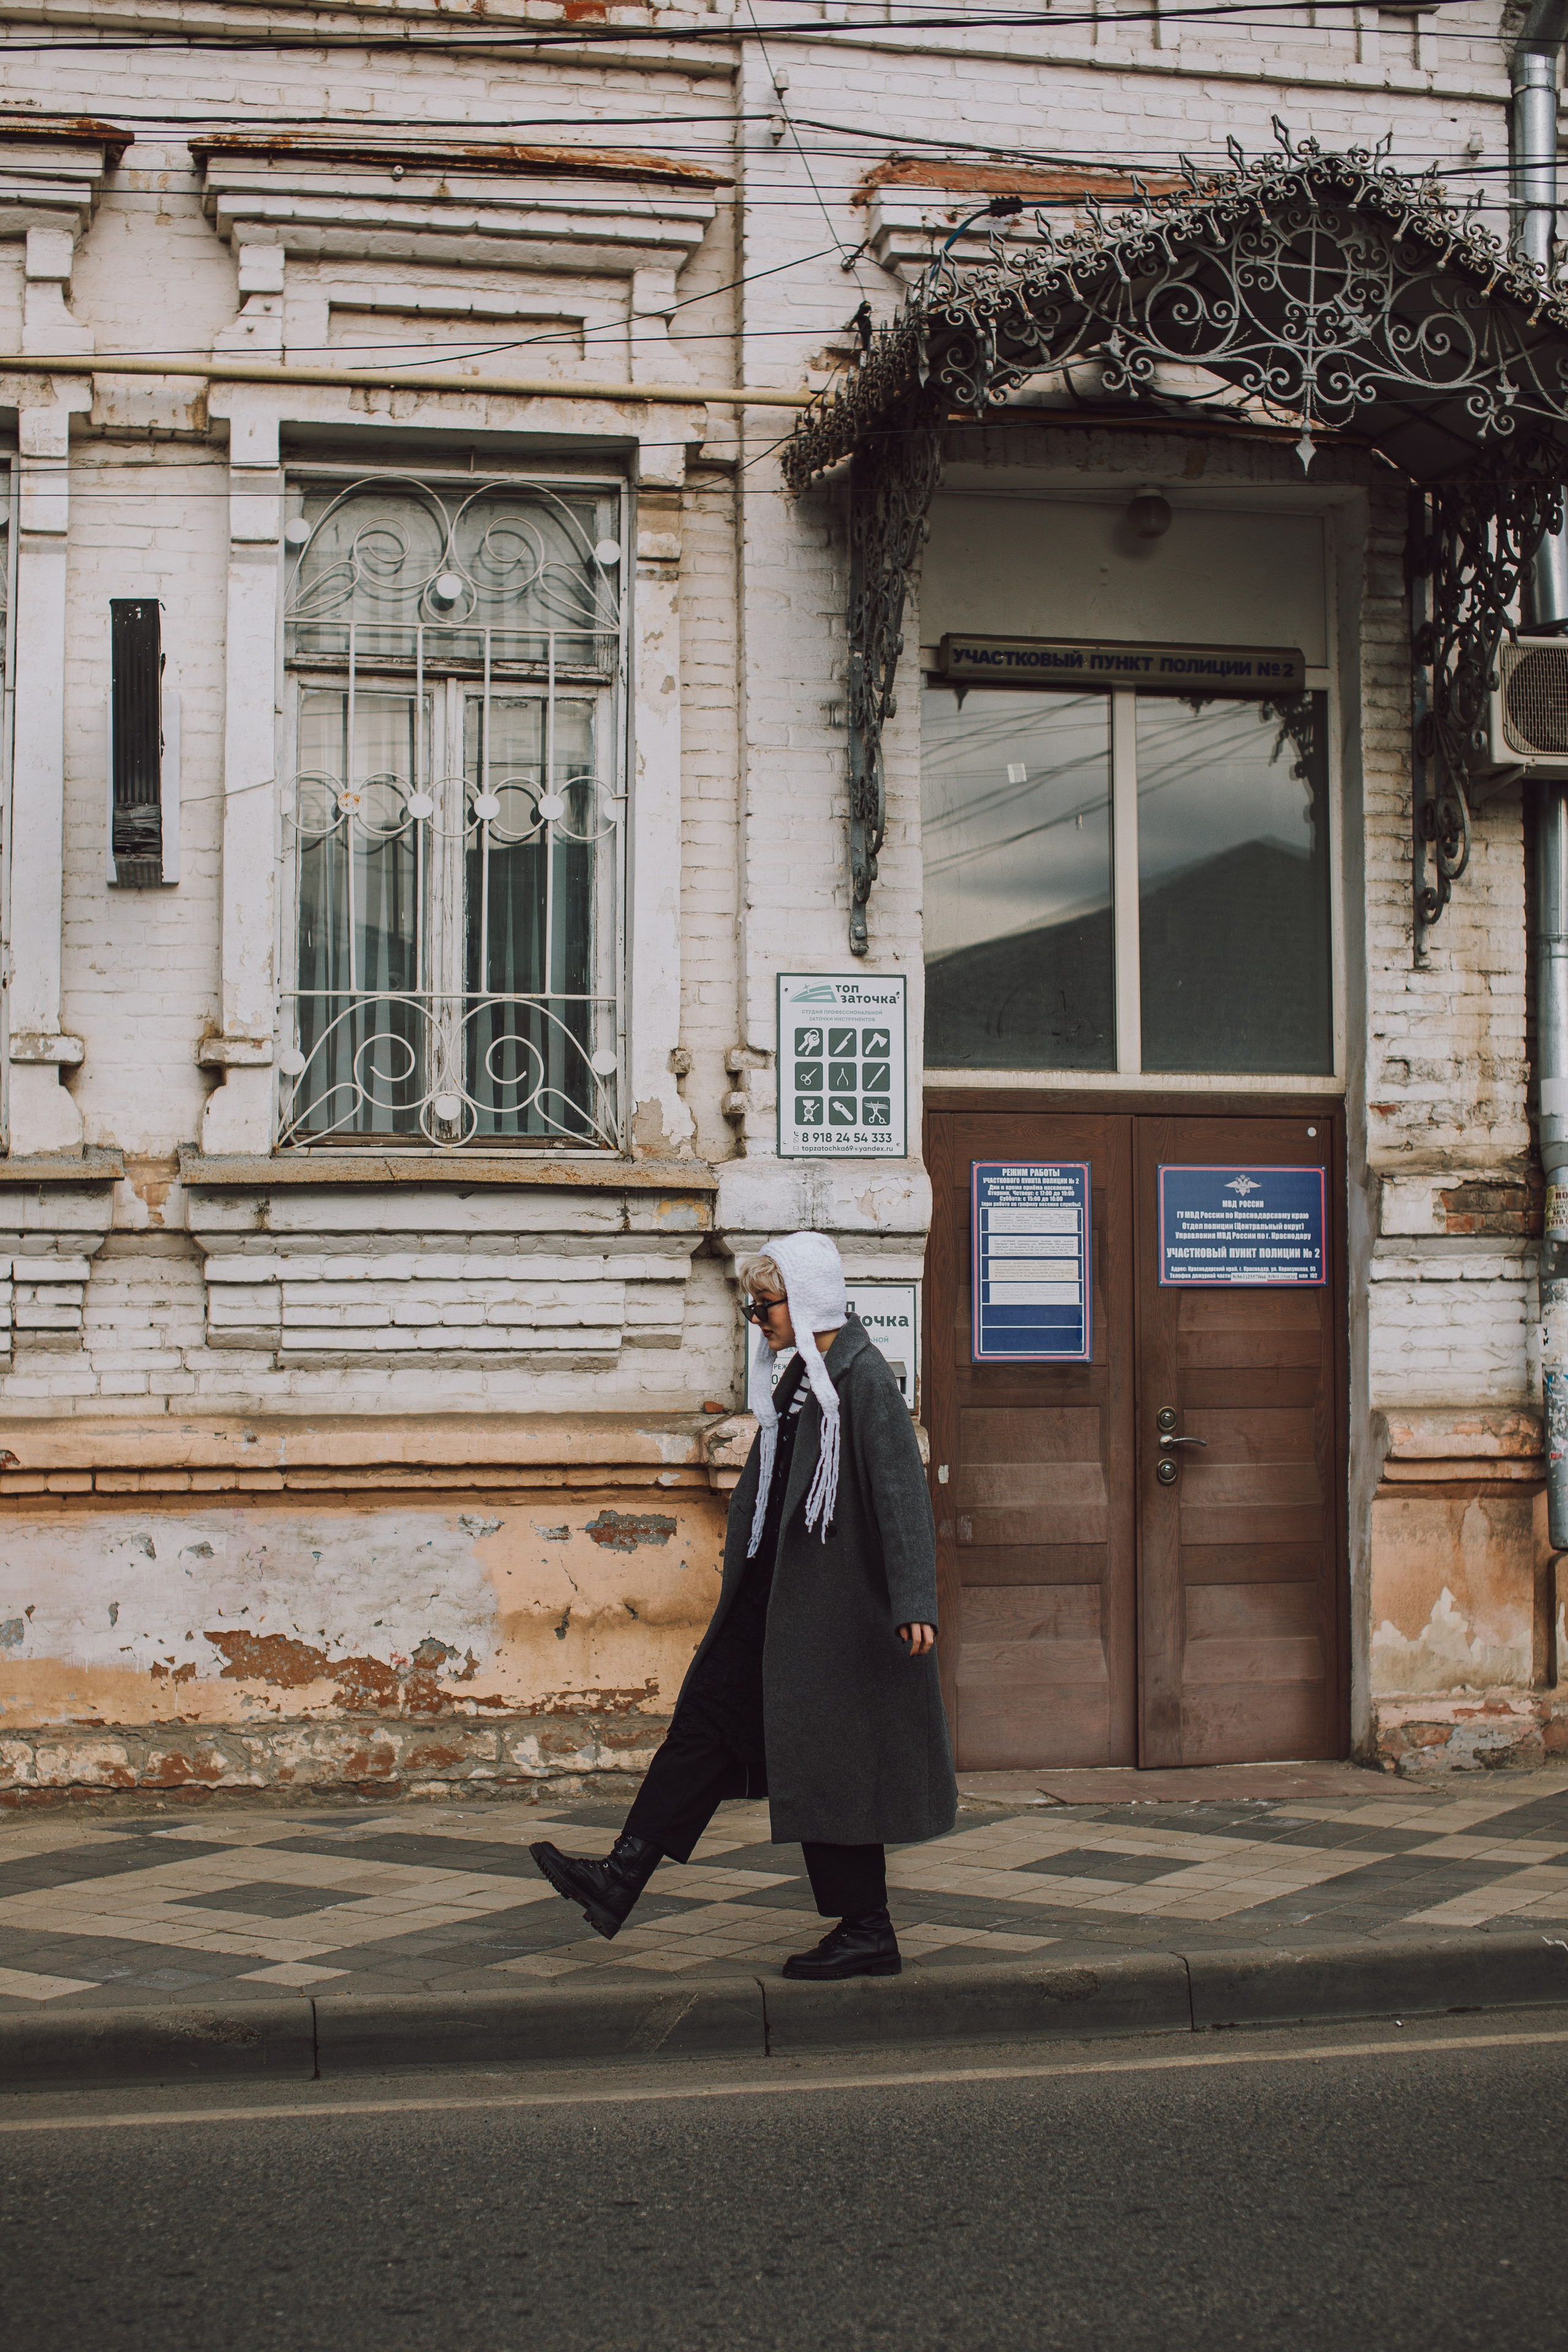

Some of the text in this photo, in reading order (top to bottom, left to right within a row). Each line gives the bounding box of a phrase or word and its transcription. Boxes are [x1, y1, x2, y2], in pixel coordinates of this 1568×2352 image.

[953, 649, 1083, 668] УЧАСТКОВЫЙ
[1090, 655, 1154, 672] ПУНКТ
[1160, 657, 1252, 677] ПОЛИЦИИ
[840, 995, 897, 1004] заточка
[802, 1133, 892, 1142] 8 918 24 54 333
[1002, 1168, 1060, 1177] РЕЖИМ РАБОТЫ
[1222, 1200, 1237, 1208] МВД
[1185, 1211, 1200, 1219] МВД
[1182, 1222, 1203, 1231] Отдел
[1234, 1222, 1283, 1231] (Центральный
[1283, 1223, 1305, 1231] округ)
[1216, 1232, 1231, 1240] МВД
[1271, 1232, 1311, 1240] Краснодару
[1166, 1246, 1320, 1259] УЧАСТКОВЫЙ ПУНКТ ПОЛИЦИИ № 2
[859, 1315, 909, 1327] очка
